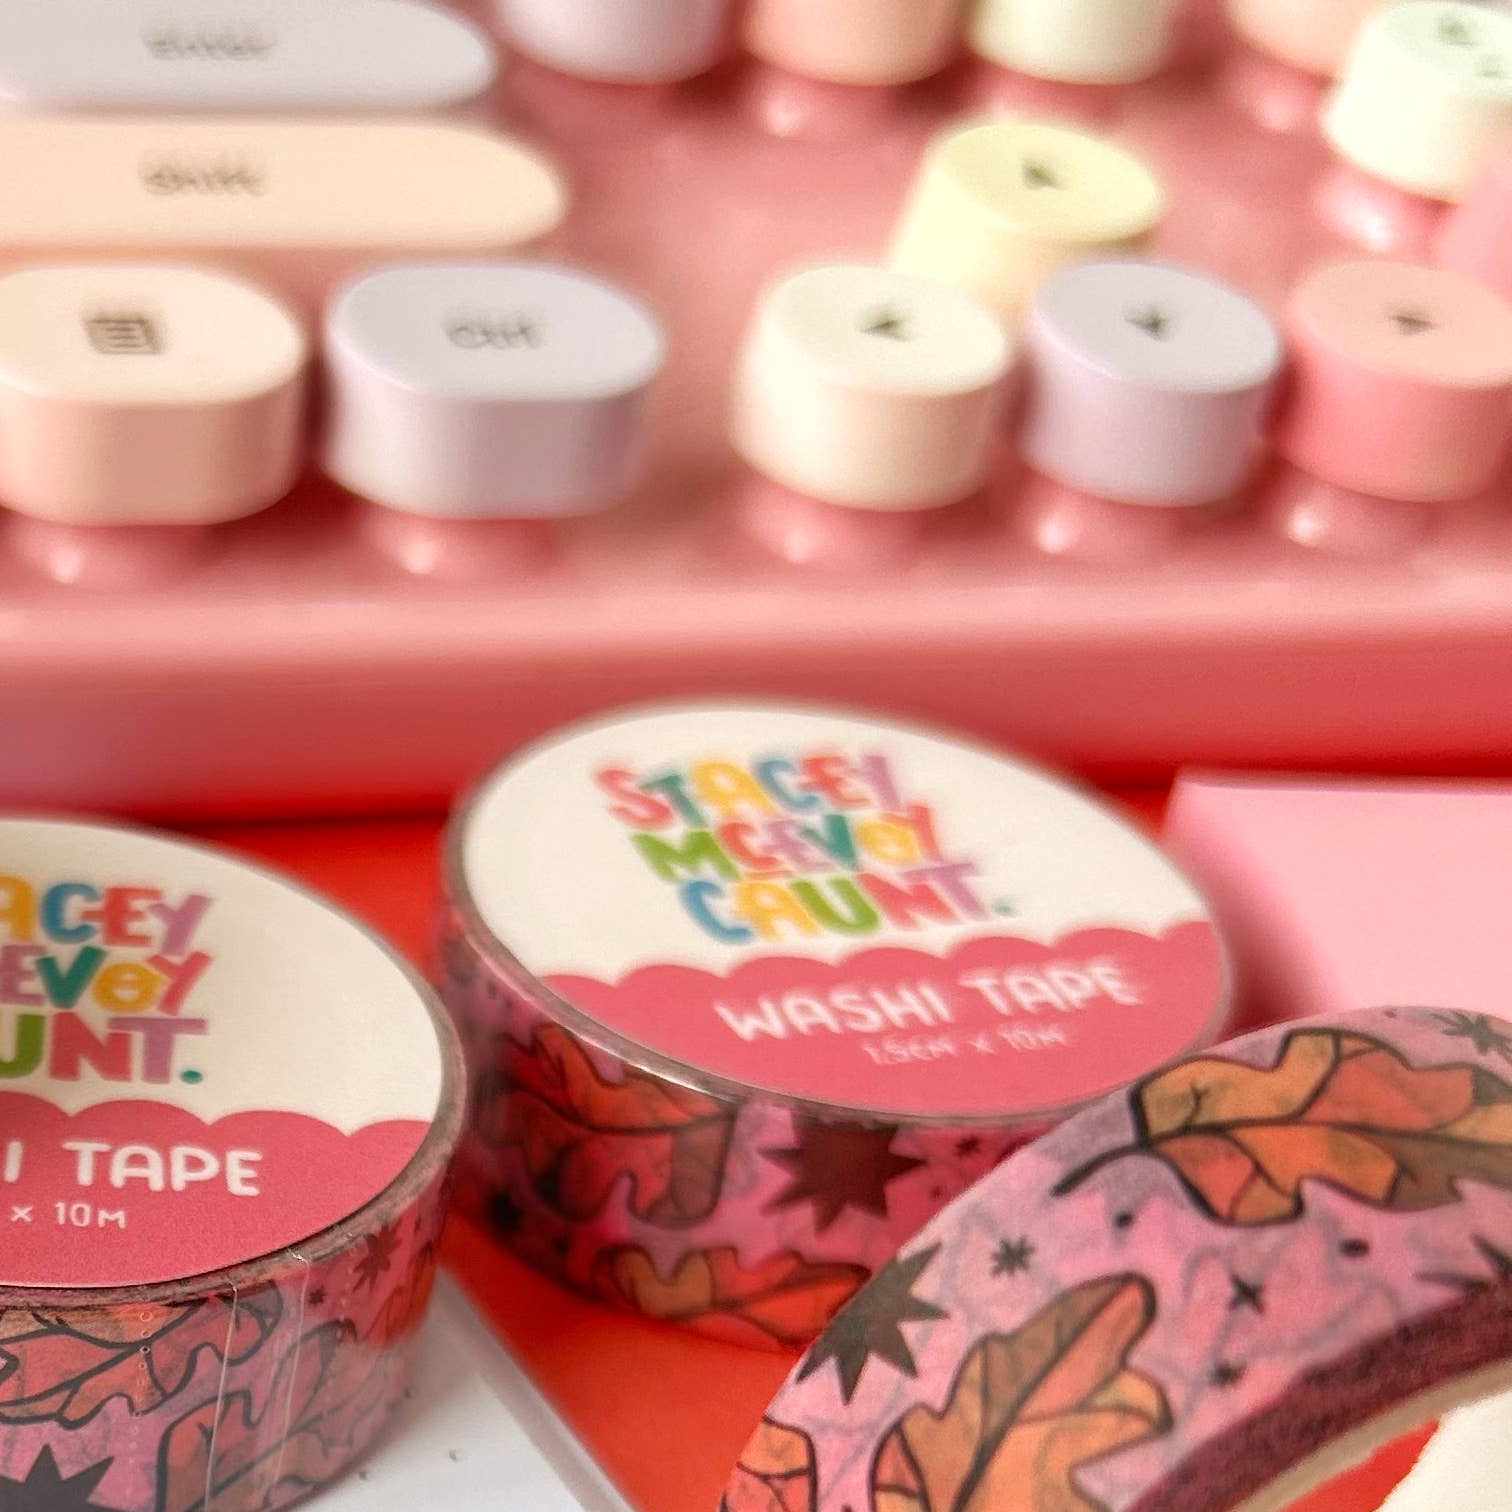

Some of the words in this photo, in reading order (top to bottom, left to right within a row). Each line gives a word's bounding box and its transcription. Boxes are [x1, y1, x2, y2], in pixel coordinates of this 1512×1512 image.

[594, 754, 902, 829] STACEY
[680, 862, 1018, 945] CAUNT.
[712, 980, 955, 1042] WASHI
[958, 960, 1144, 1016] TAPE
[61, 1140, 264, 1198] TAPE
